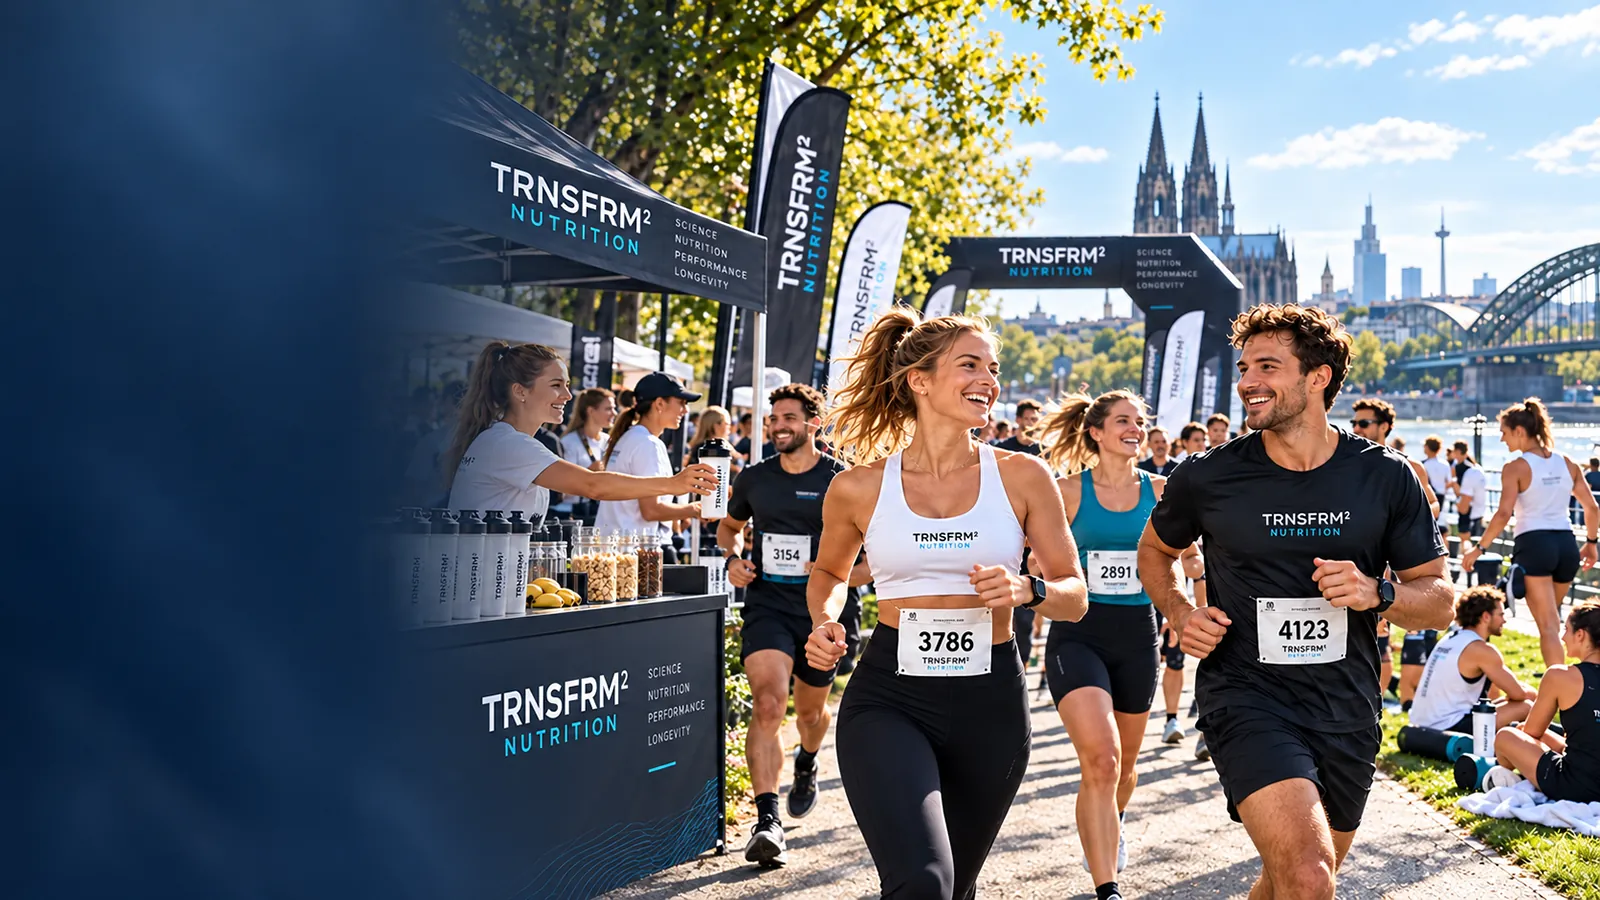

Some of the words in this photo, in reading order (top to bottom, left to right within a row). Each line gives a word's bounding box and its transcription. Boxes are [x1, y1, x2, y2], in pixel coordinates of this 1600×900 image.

[490, 161, 652, 234] TRNSFRM²
[777, 134, 818, 290] TRNSFRM²
[511, 203, 639, 255] NUTRITION
[675, 218, 718, 240] SCIENCE
[803, 169, 830, 293] NUTRITION
[675, 234, 728, 258] NUTRITION
[998, 246, 1106, 264] TRNSFRM²
[1136, 249, 1173, 257] SCIENCE
[674, 250, 748, 280] PERFORMANCE
[1009, 266, 1093, 277] NUTRITION
[1136, 270, 1198, 278] PERFORMANCE
[674, 266, 729, 290] LONGEVITY
[1136, 281, 1185, 289] LONGEVITY
[1262, 510, 1351, 526] TRNSFRM²
[912, 530, 979, 542] TRNSFRM²
[1270, 528, 1341, 537] NUTRITION
[773, 548, 800, 561] 3154
[1100, 565, 1131, 579] 2891
[1278, 619, 1330, 640] 4123
[918, 631, 974, 652] 3786
[648, 662, 682, 679] SCIENCE
[481, 669, 629, 733] TRNSFRM²
[648, 682, 691, 701] NUTRITION
[648, 700, 706, 724] PERFORMANCE
[504, 714, 618, 757] NUTRITION
[648, 724, 691, 746] LONGEVITY
